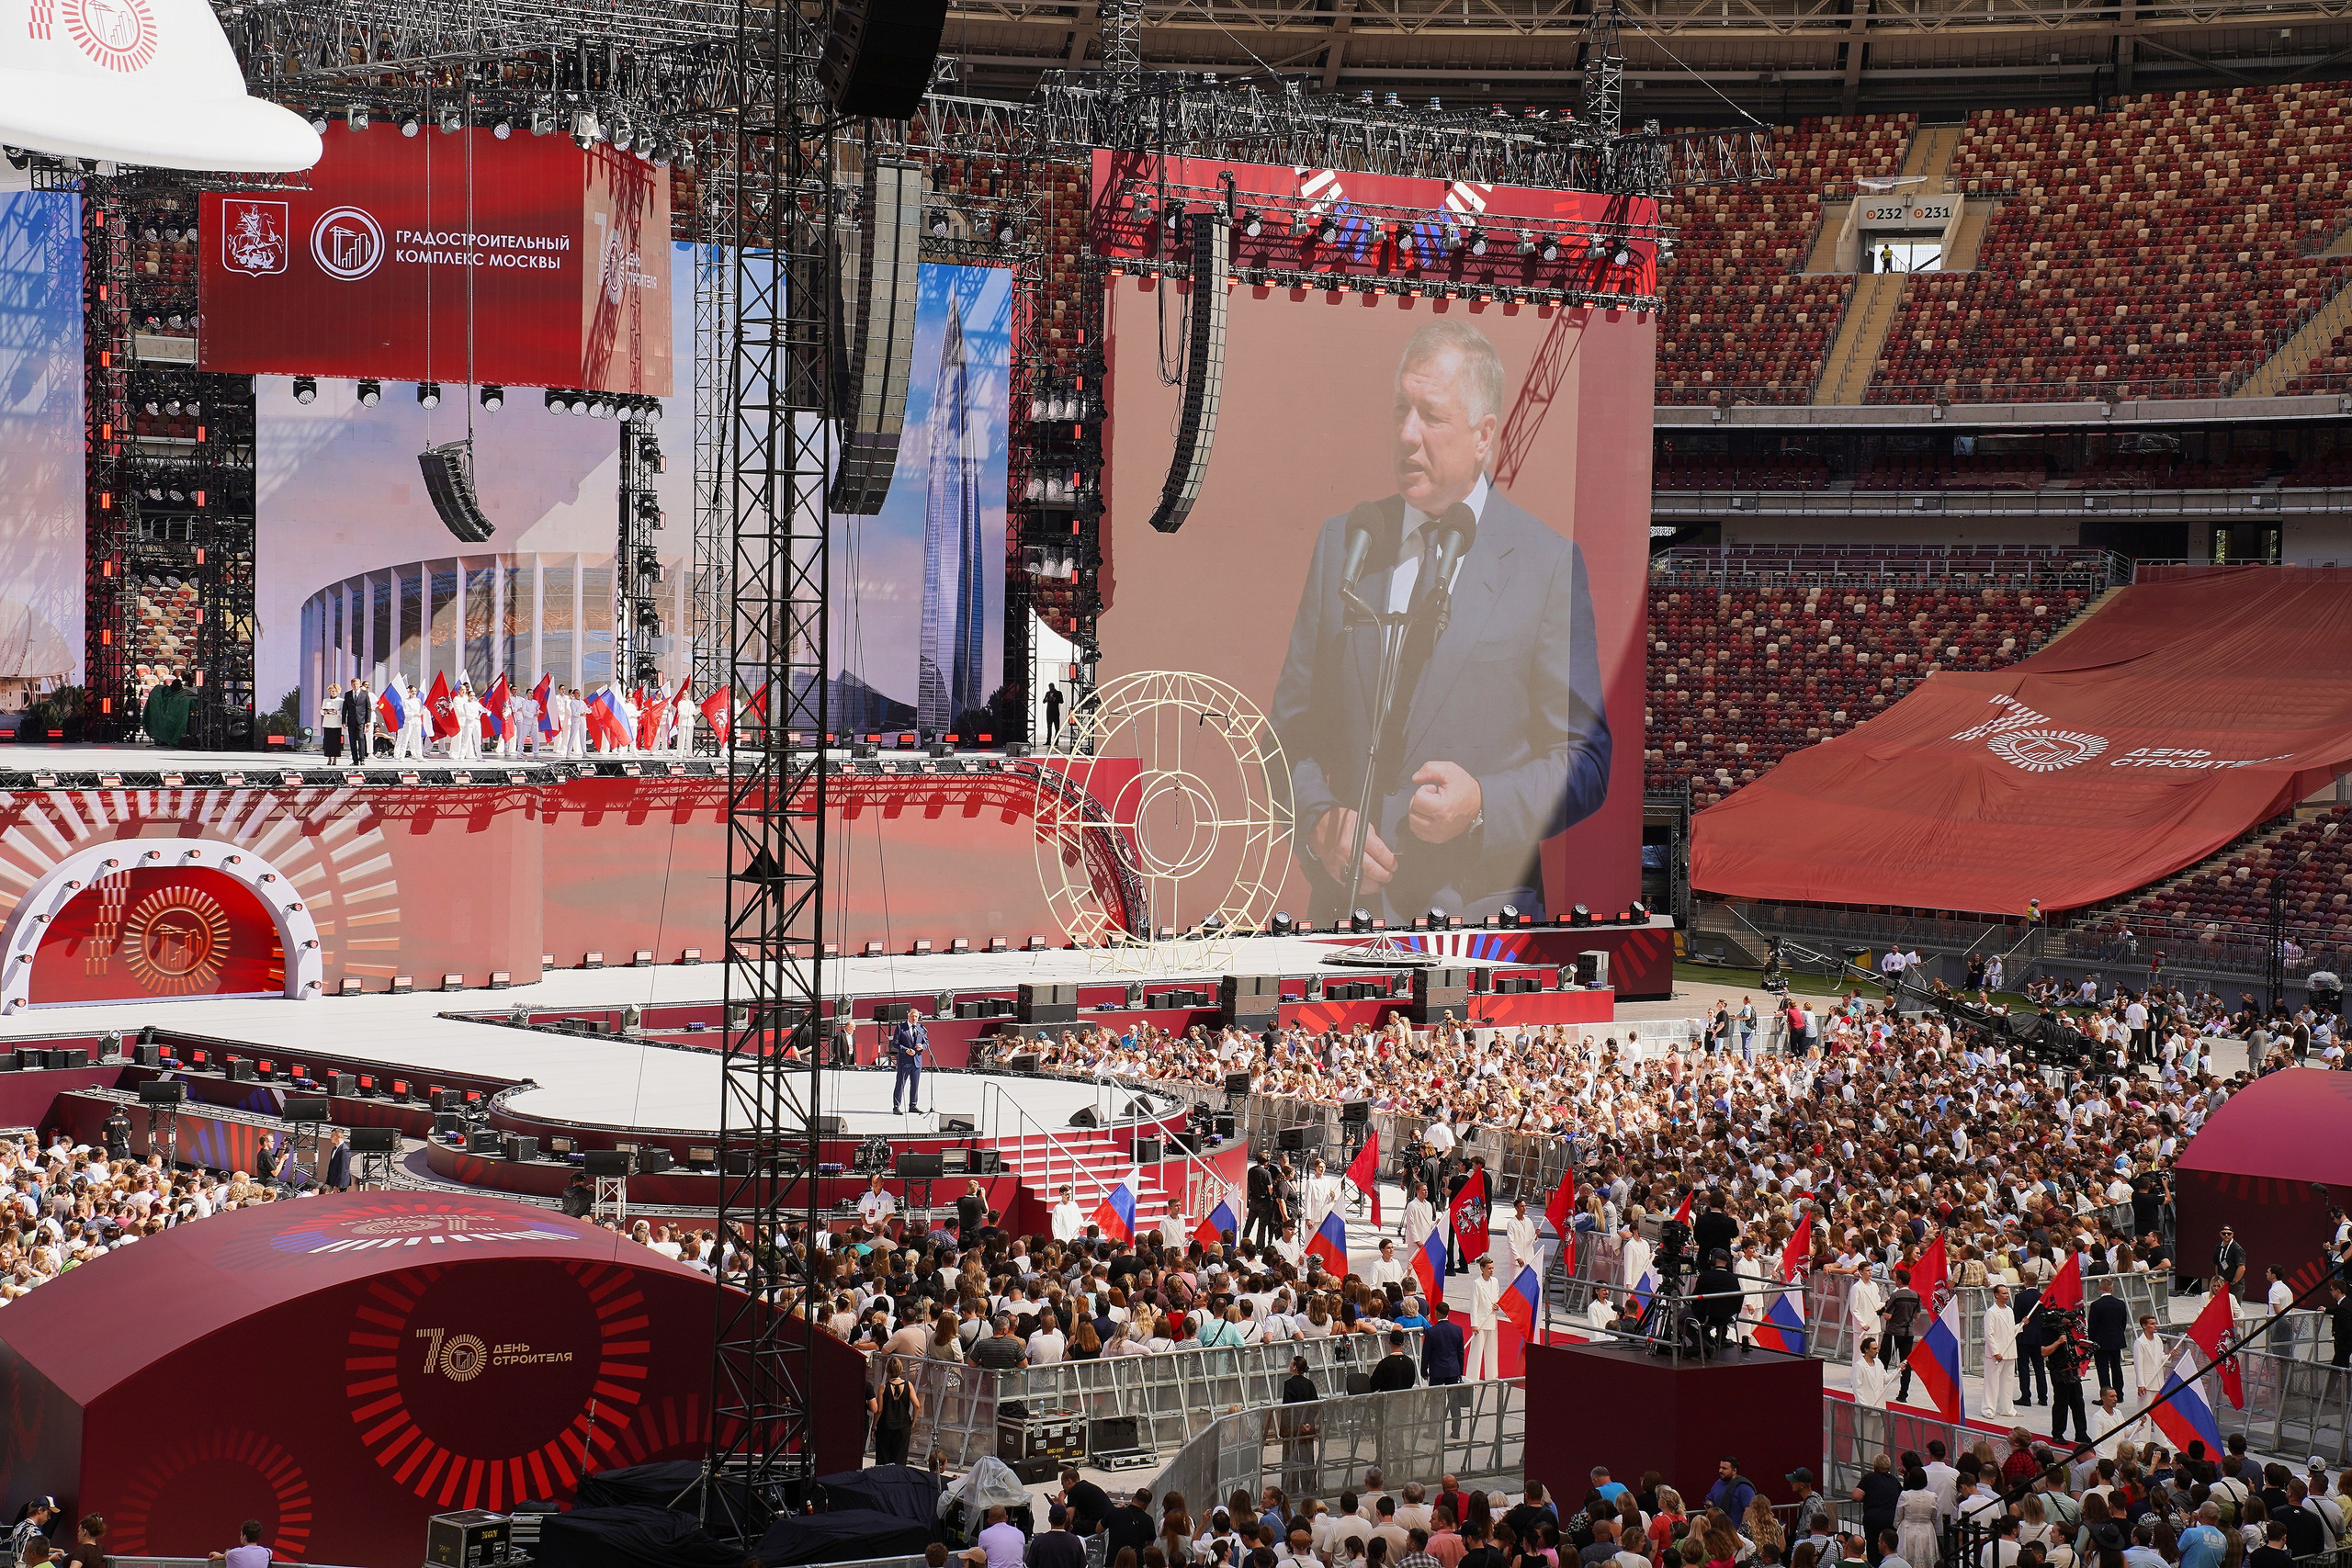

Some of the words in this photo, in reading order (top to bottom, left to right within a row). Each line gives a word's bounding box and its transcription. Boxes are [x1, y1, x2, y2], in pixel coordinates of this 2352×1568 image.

[1876, 208, 1902, 220] 232
[1924, 207, 1951, 219] 231
[396, 231, 570, 251] ГРАДОСТРОИТЕЛЬНЫЙ
[396, 249, 484, 265] КОМПЛЕКС
[489, 254, 560, 269] МОСКВЫ
[2124, 747, 2211, 759] ДЕНЬ
[2109, 753, 2295, 770] СТРОИТ
[492, 1343, 530, 1354] ДЕНЬ
[492, 1352, 573, 1366] СТРОИТЕЛЯ
